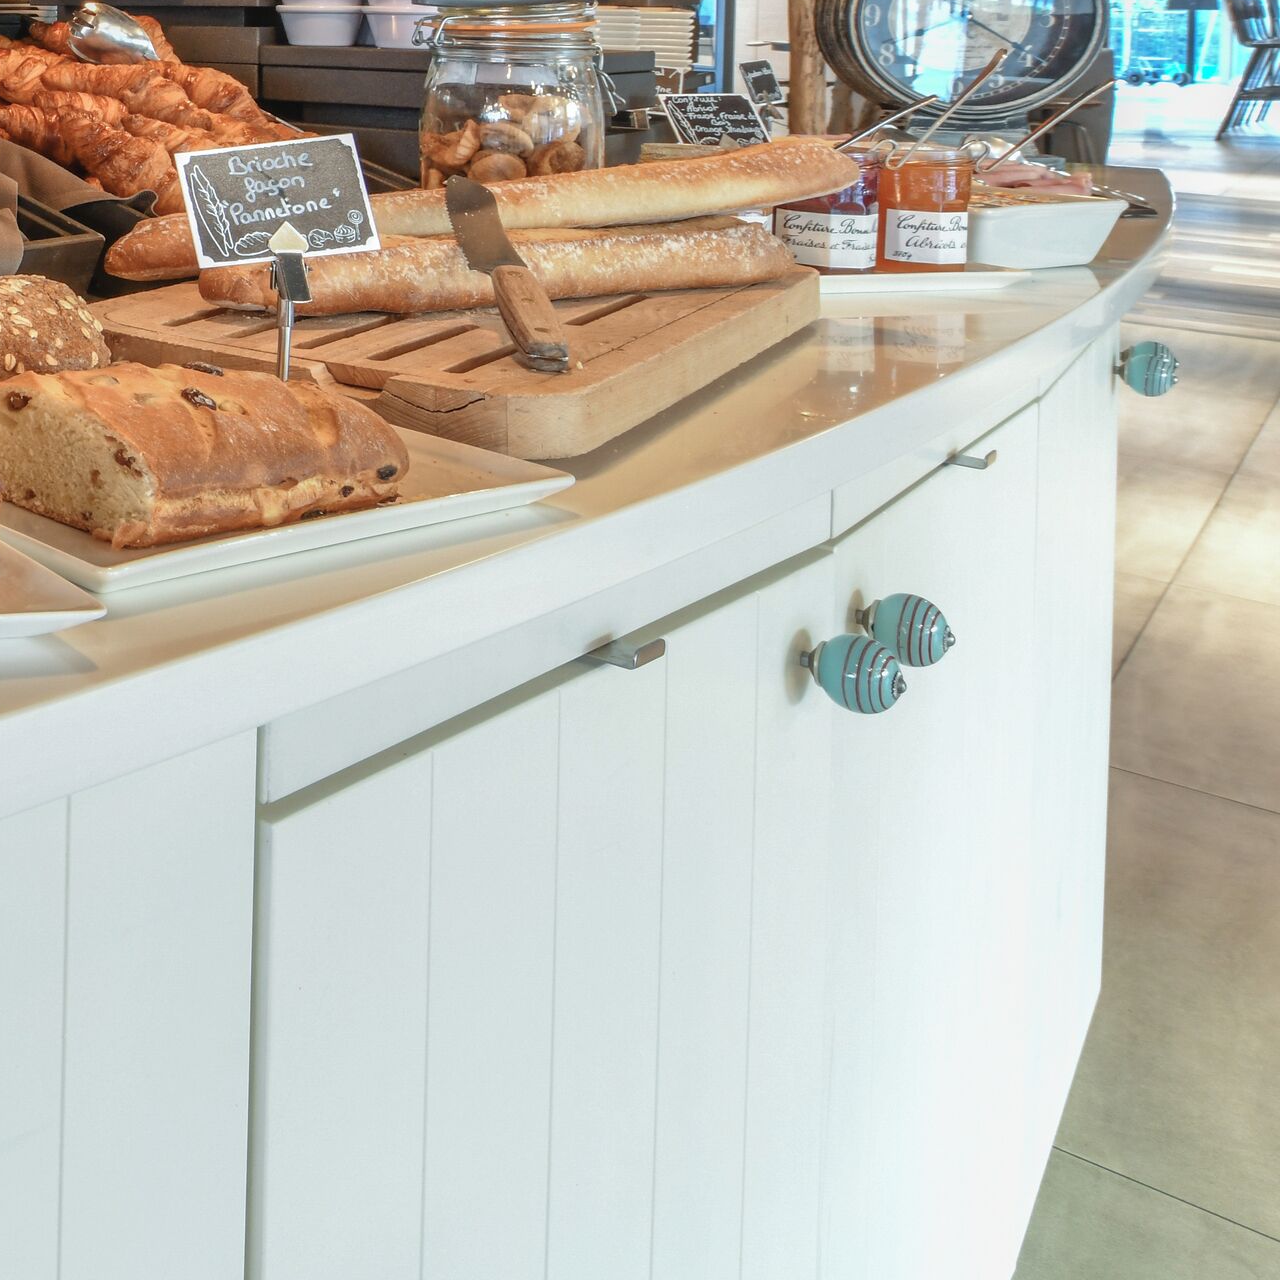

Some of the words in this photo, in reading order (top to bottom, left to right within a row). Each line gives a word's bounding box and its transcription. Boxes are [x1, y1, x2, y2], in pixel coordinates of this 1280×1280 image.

[865, 4, 881, 26] 9
[879, 43, 895, 66] 8
[228, 151, 314, 175] Brioche
[244, 176, 306, 203] façon
[784, 214, 837, 234] Confiture
[897, 215, 947, 233] Confiture
[906, 236, 956, 249] Abricots
